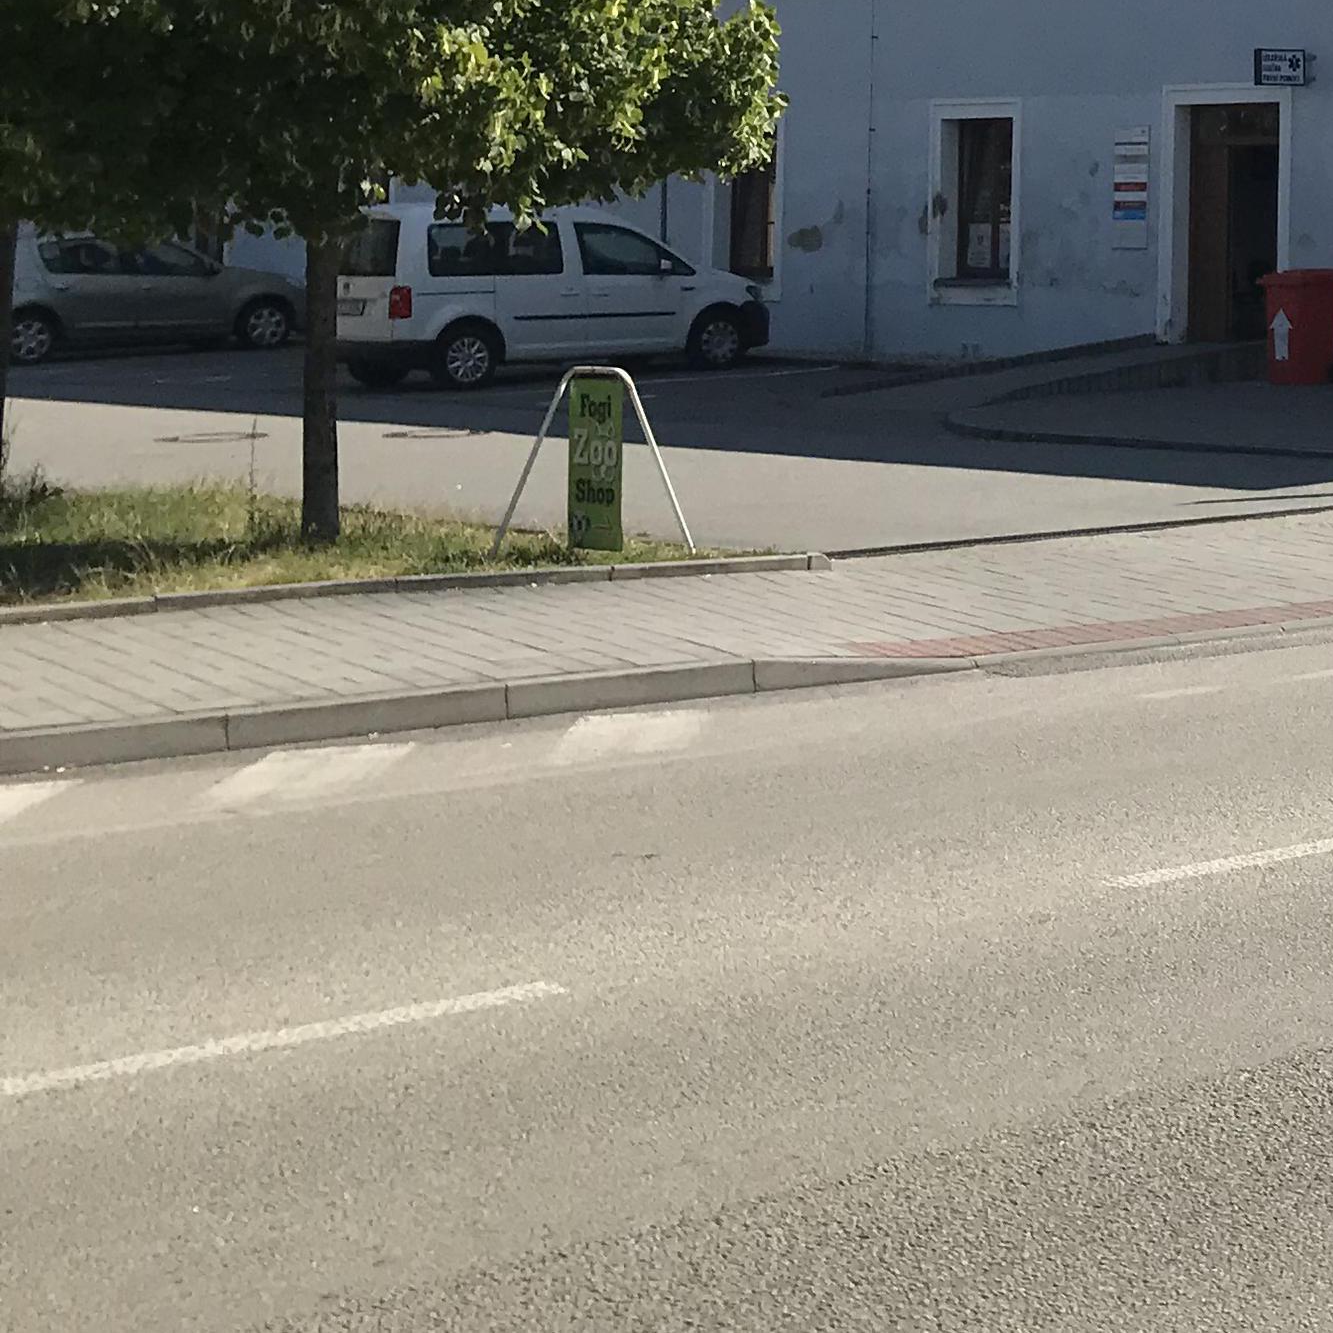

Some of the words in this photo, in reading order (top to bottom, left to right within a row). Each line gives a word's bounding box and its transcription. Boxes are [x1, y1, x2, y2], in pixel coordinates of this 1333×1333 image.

[580, 393, 611, 424] Fogi
[573, 428, 618, 467] Zoo
[575, 477, 615, 507] Shop
